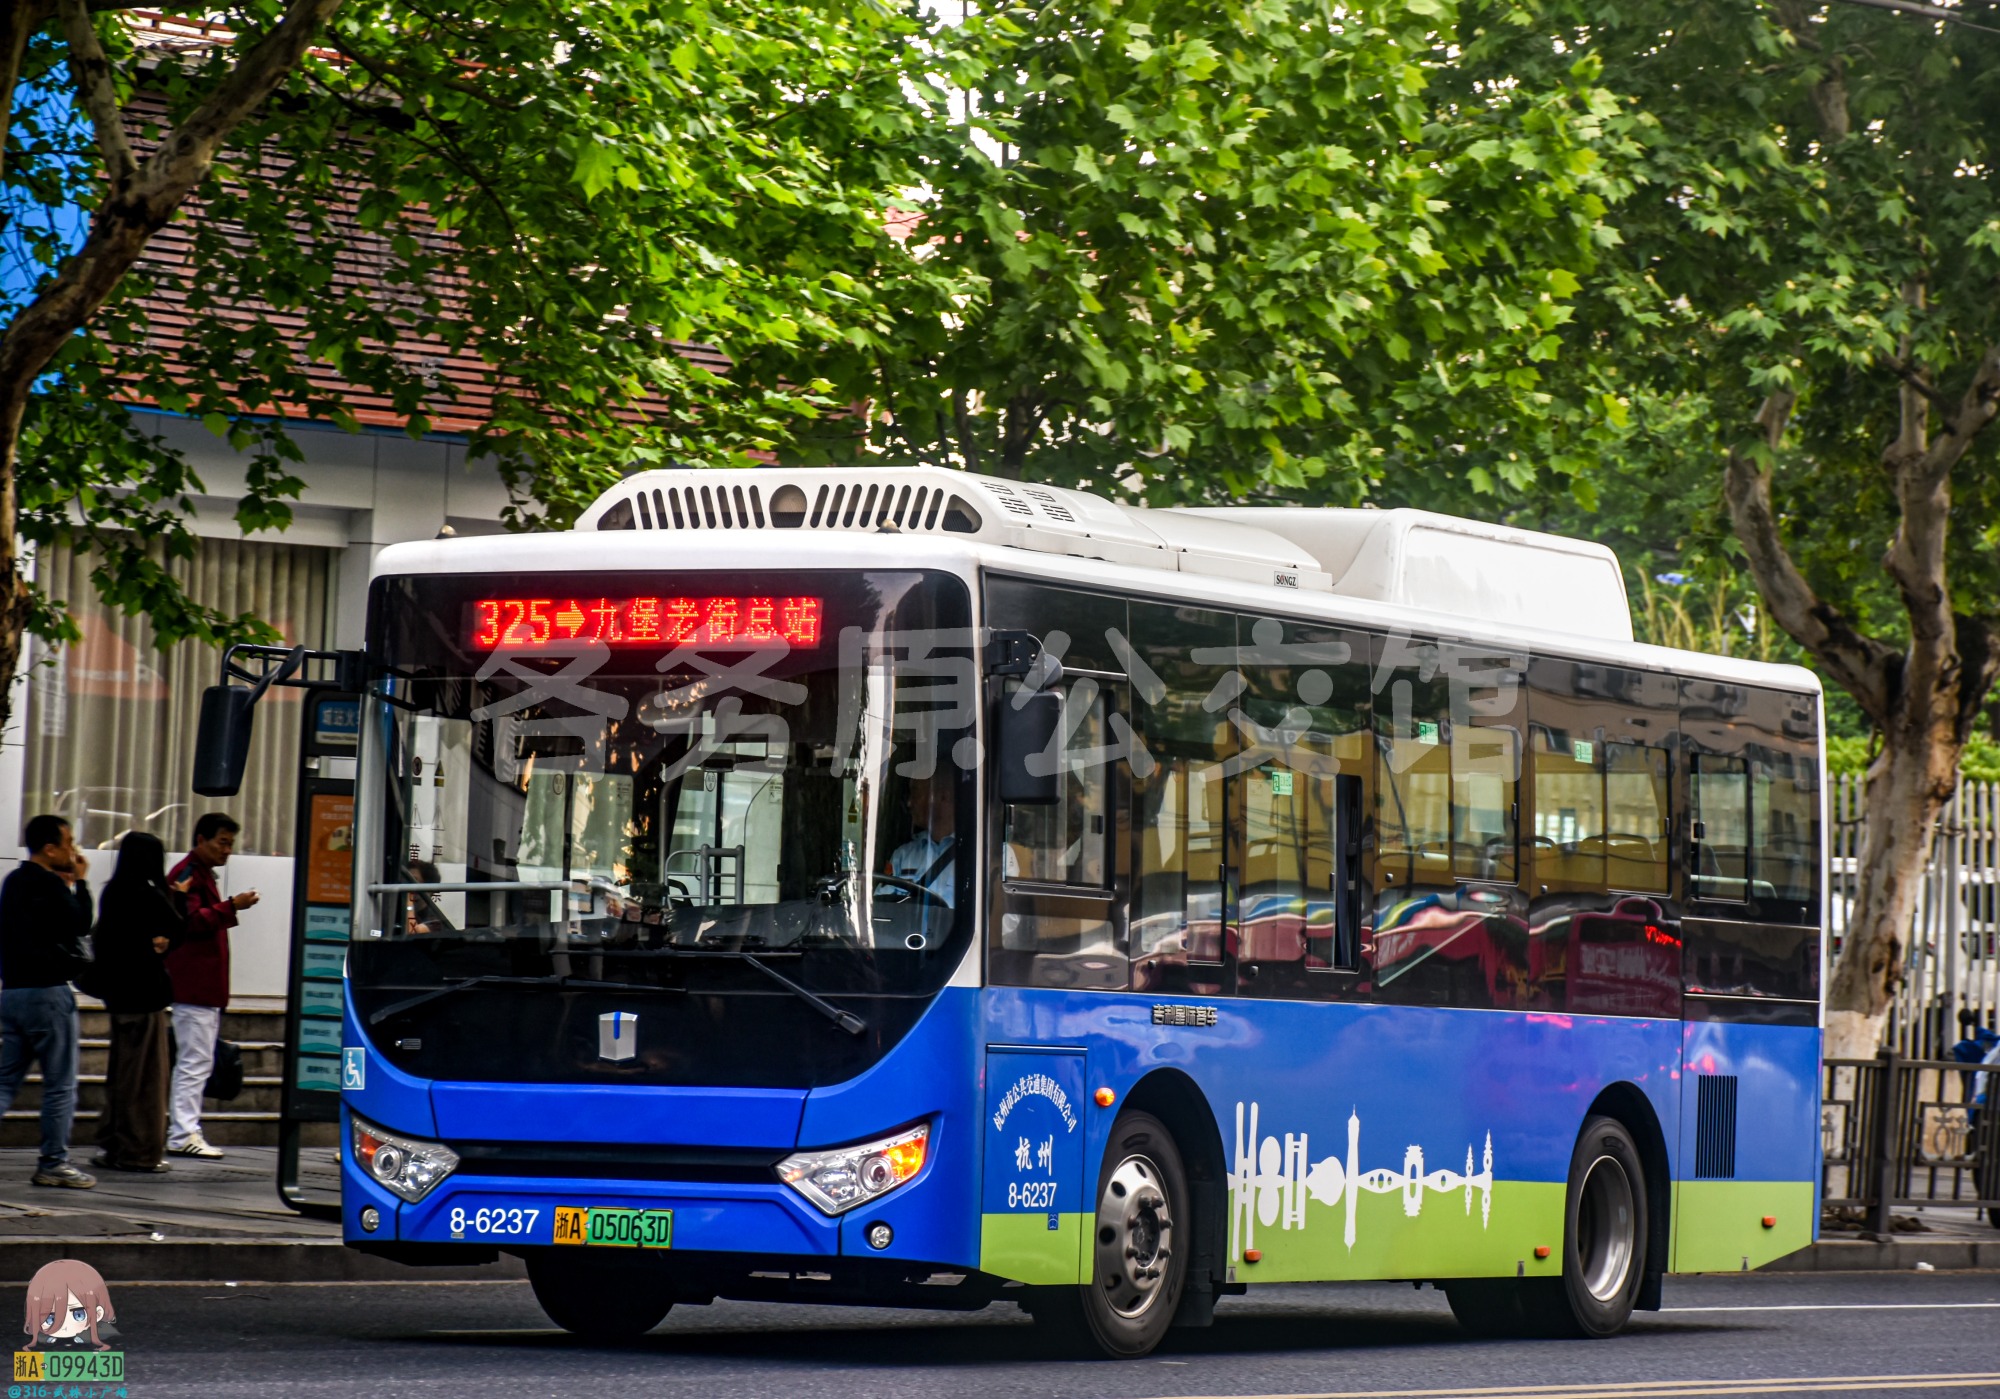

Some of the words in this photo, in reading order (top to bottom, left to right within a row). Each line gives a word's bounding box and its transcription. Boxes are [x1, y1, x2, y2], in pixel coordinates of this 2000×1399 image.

[1276, 574, 1297, 587] SONGZ
[480, 601, 551, 644] 325
[590, 598, 817, 643] 九堡老街总站
[1152, 1003, 1218, 1027] 吉利星际客车
[993, 1073, 1078, 1133] 杭州市公共交通集团有限公司
[1014, 1134, 1054, 1177] 杭州
[1008, 1182, 1058, 1208] 8-6237
[450, 1207, 540, 1234] 8-6237
